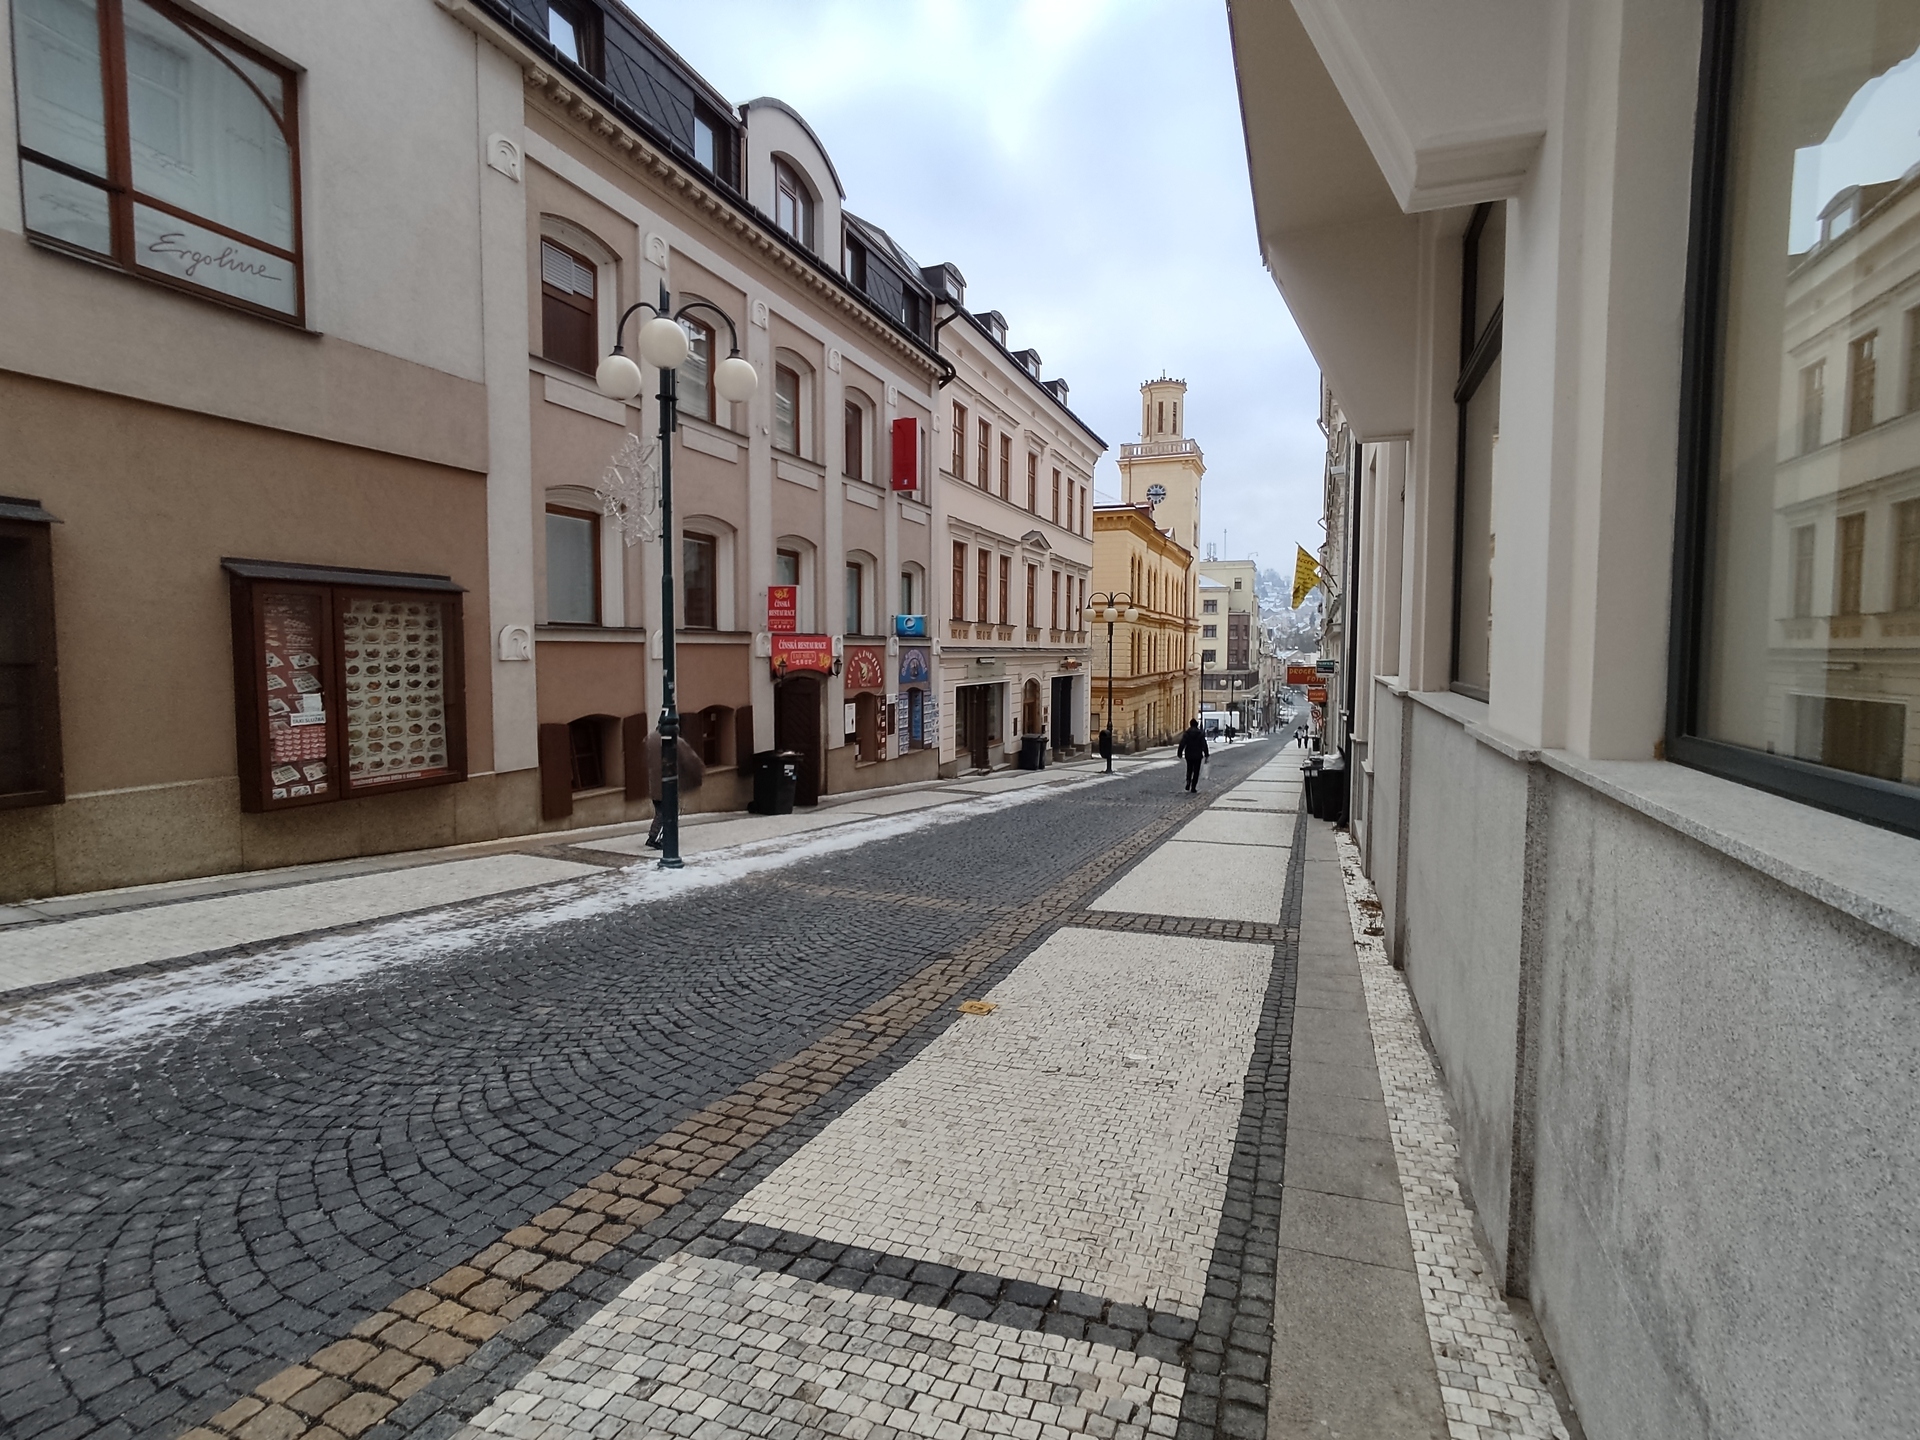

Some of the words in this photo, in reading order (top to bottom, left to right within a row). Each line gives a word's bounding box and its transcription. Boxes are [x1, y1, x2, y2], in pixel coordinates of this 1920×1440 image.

[149, 233, 282, 281] Ergoline
[774, 600, 790, 608] ČÍNSKÁ
[769, 609, 795, 617] RESTAURACE
[778, 639, 797, 650] ČÍNSKÁ
[797, 641, 827, 650] RESTAURACE
